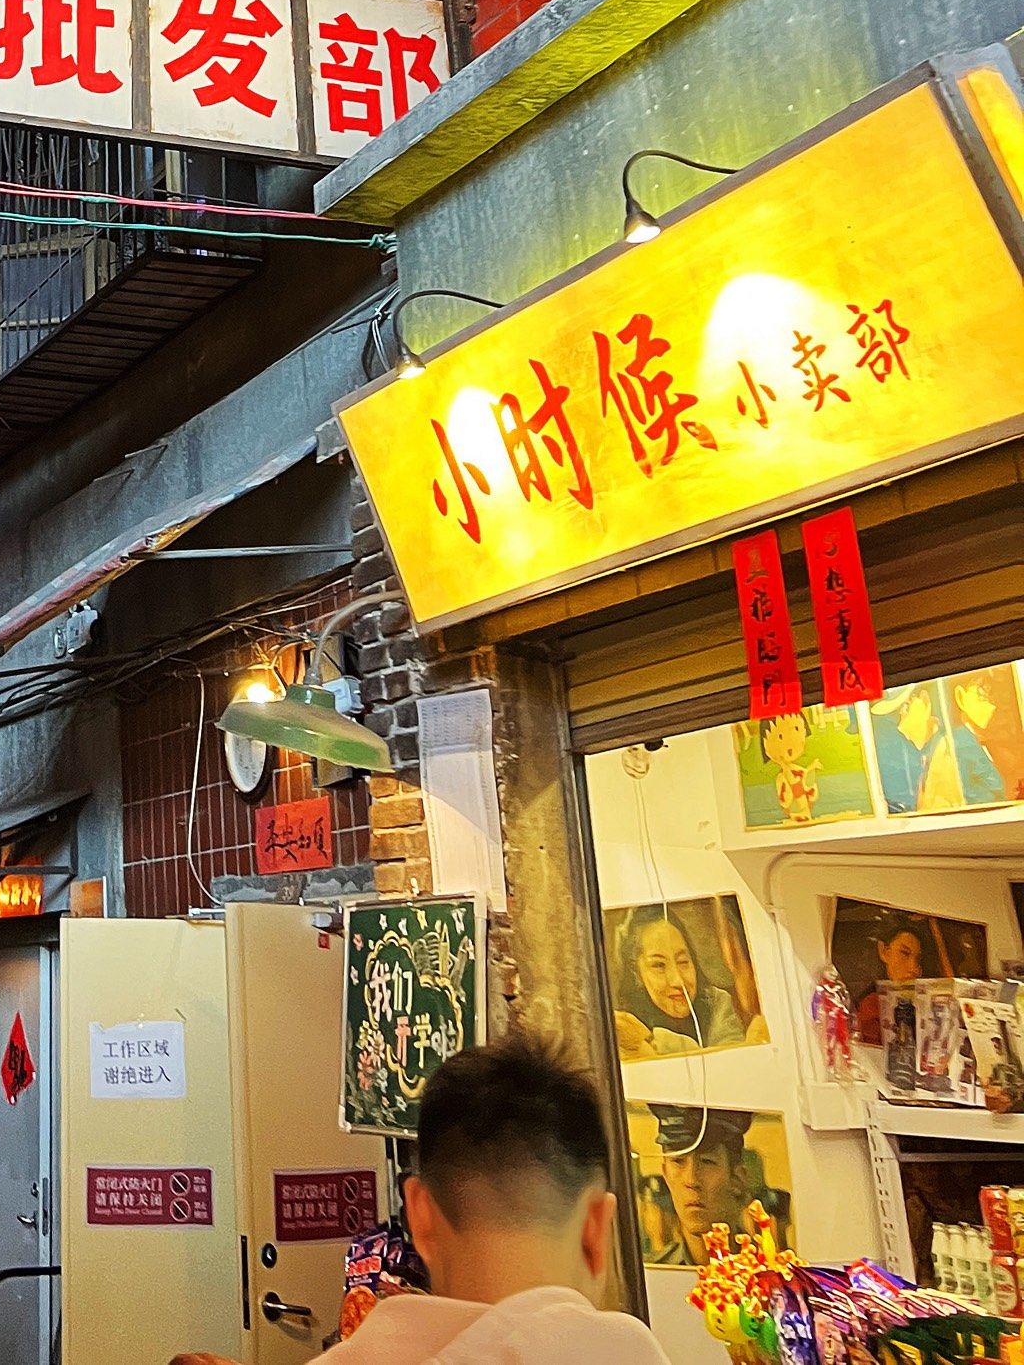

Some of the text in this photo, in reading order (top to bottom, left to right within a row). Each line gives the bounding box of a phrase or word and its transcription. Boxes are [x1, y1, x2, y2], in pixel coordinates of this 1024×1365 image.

[432, 299, 912, 544] 小时候 小卖部
[368, 959, 414, 1022] 我们
[103, 1039, 169, 1058] 工作区域
[103, 1065, 171, 1085] 谢绝进入
